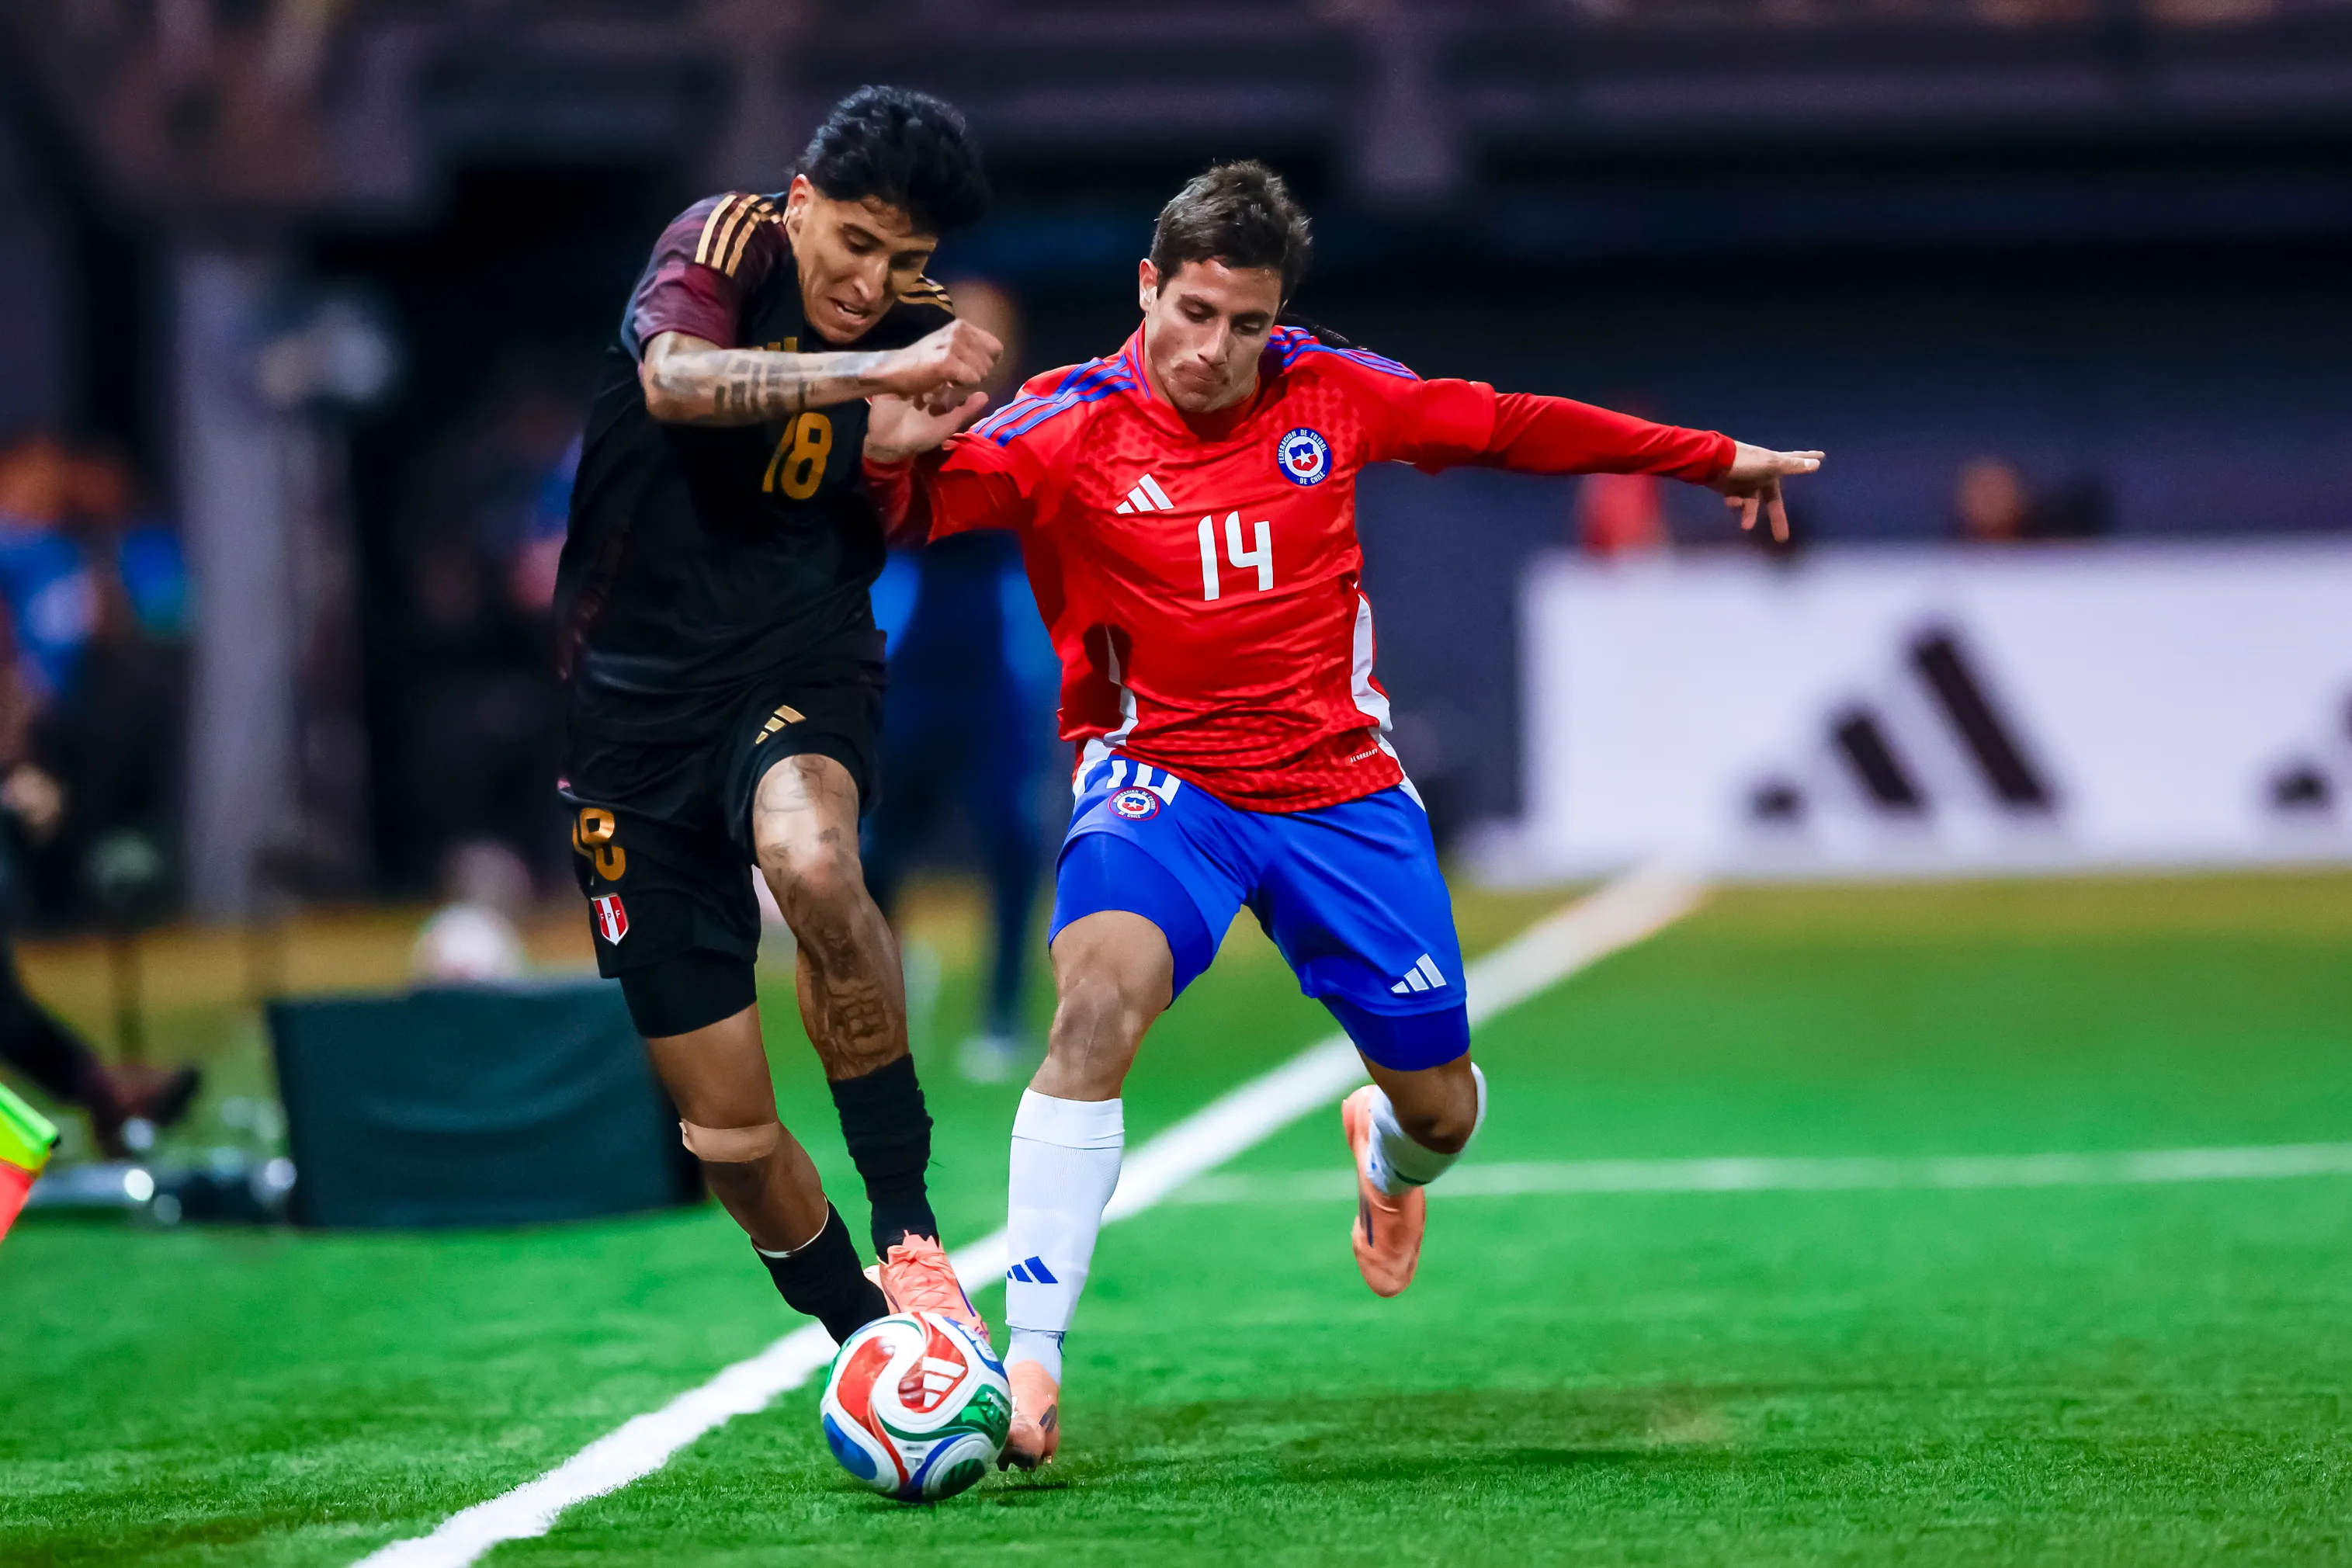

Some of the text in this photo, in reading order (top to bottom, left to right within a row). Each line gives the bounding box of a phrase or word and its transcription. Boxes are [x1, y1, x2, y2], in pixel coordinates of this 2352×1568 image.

[761, 411, 833, 500] 18
[1310, 470, 1326, 484] CHILE
[1197, 511, 1274, 601] 14
